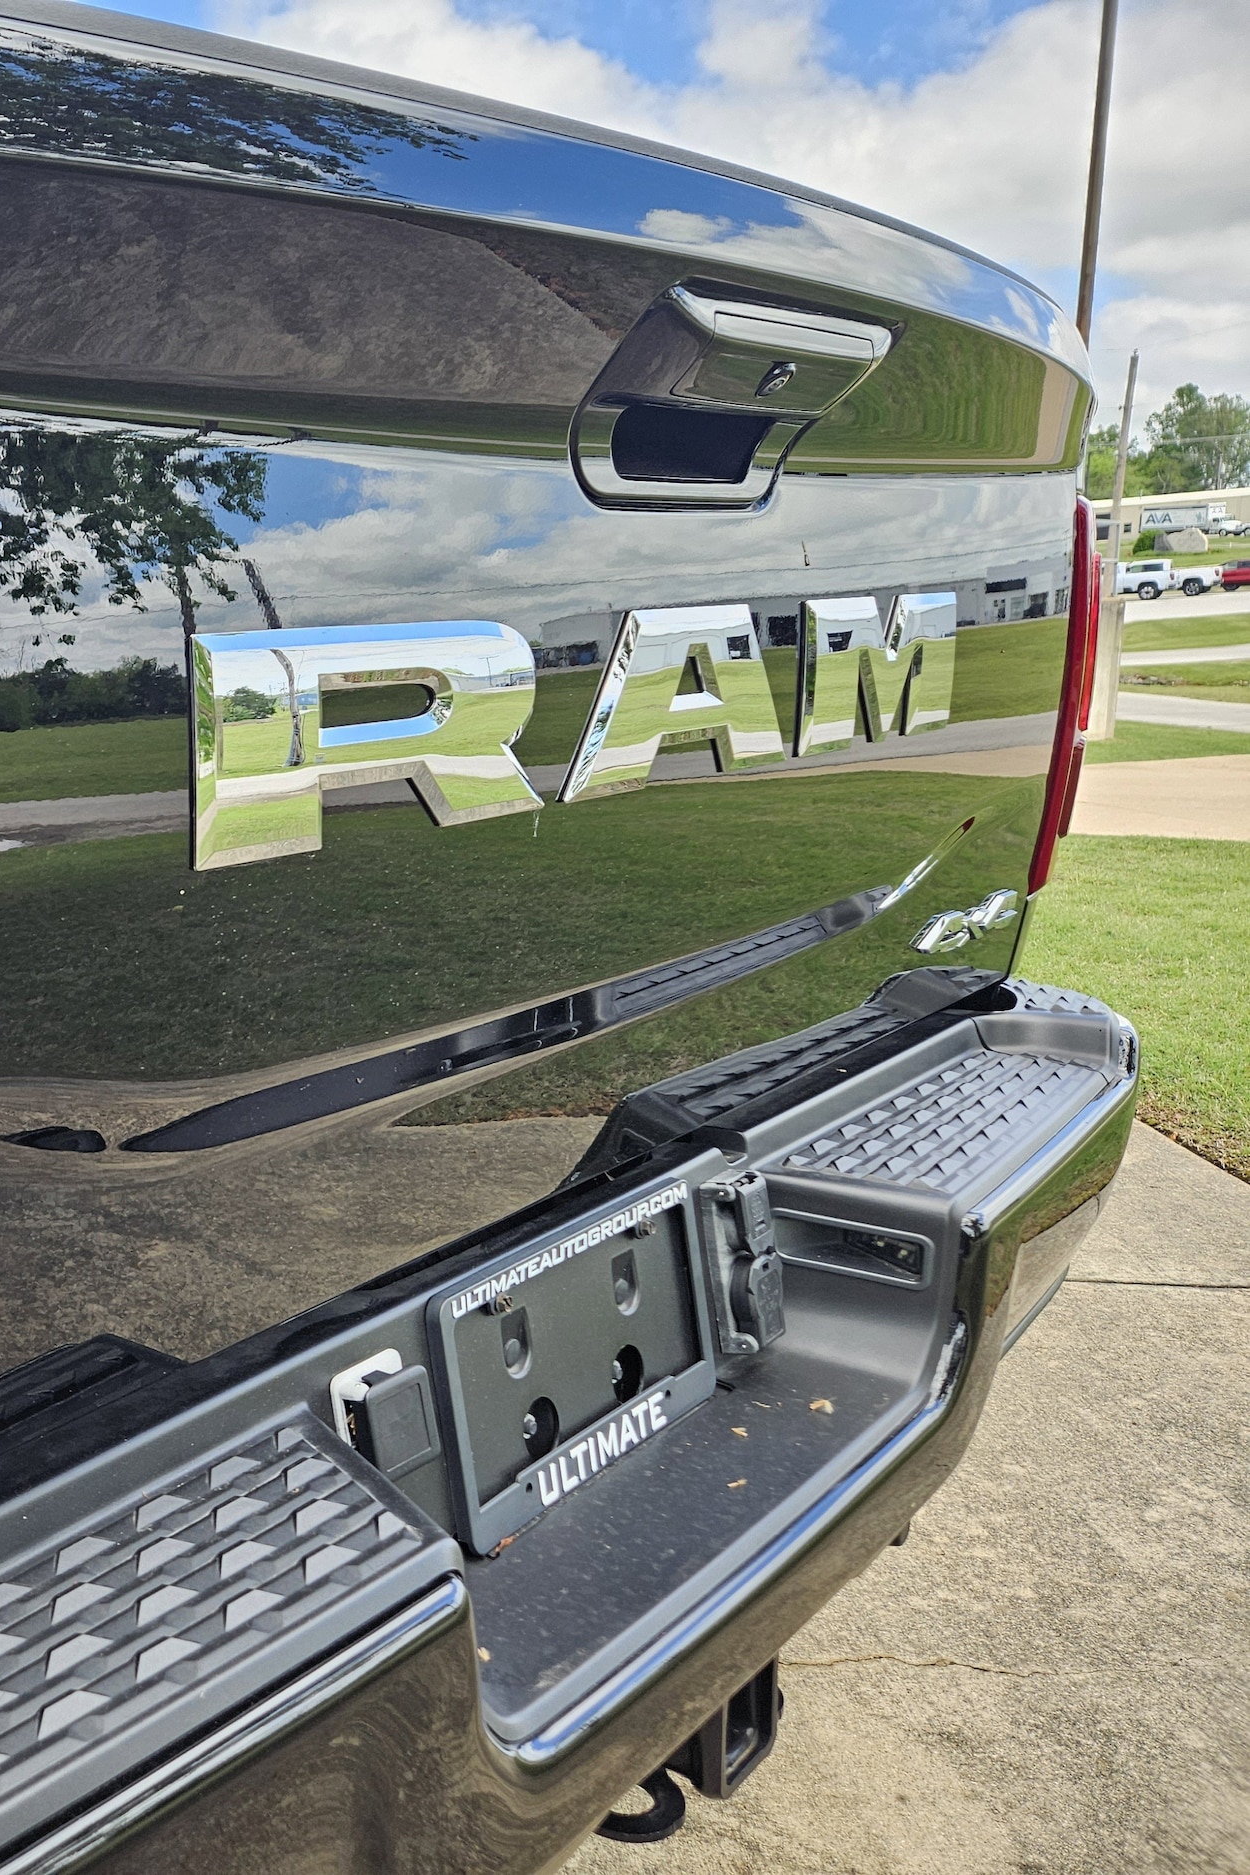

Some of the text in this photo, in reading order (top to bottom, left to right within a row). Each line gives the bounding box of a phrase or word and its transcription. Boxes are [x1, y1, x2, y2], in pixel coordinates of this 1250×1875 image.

[190, 592, 957, 871] RAM
[451, 1182, 688, 1319] ULTIMATEAUTOGROUP.COM
[537, 1391, 668, 1507] ULTIMATE
